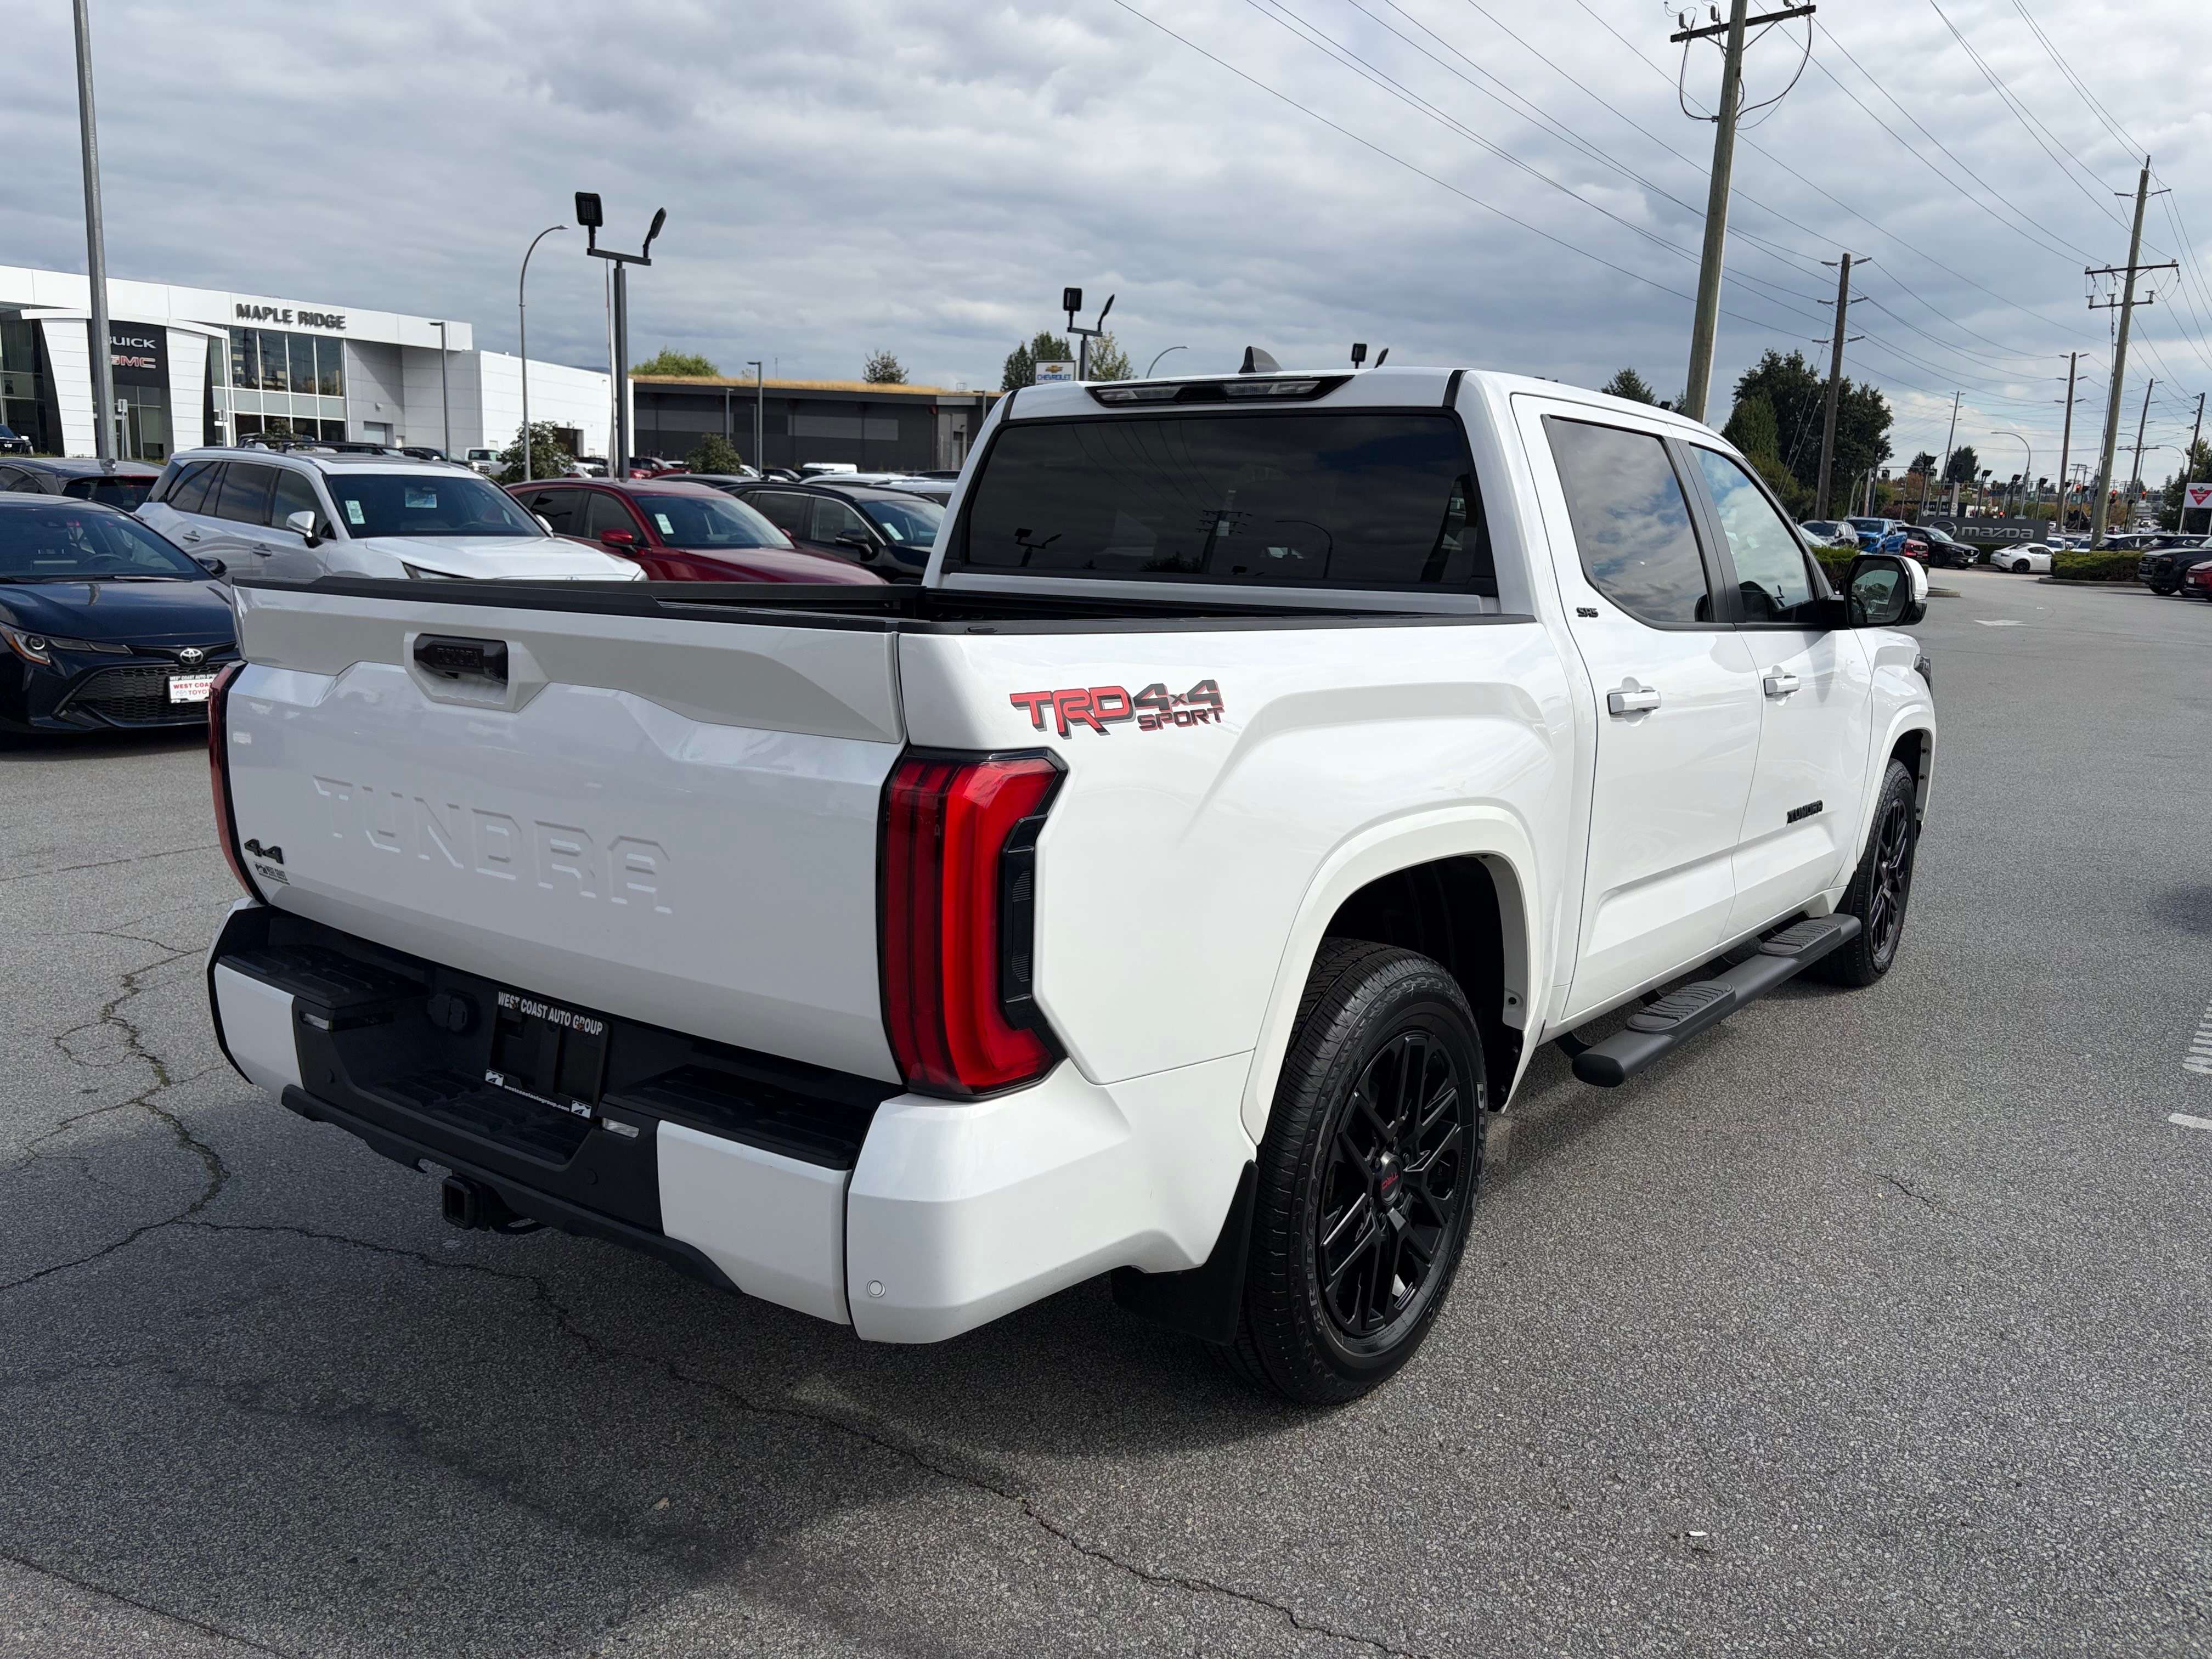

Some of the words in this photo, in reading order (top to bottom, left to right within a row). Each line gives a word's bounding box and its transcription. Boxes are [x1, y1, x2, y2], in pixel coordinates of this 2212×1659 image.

[236, 303, 294, 324] MAPLE
[298, 311, 347, 330] RIDGE
[1576, 607, 1599, 618] SR5
[1009, 685, 1136, 740] TRD
[1137, 707, 1226, 731] SPORT
[1787, 799, 1822, 824] TUNDRA
[313, 775, 673, 915] TUNDRA
[498, 991, 520, 1009] WEST
[521, 998, 548, 1019] COAST
[549, 1007, 571, 1026] AUTO
[573, 1014, 603, 1036] GROUP
[504, 1084, 570, 1112] westcoastautogroup.com
